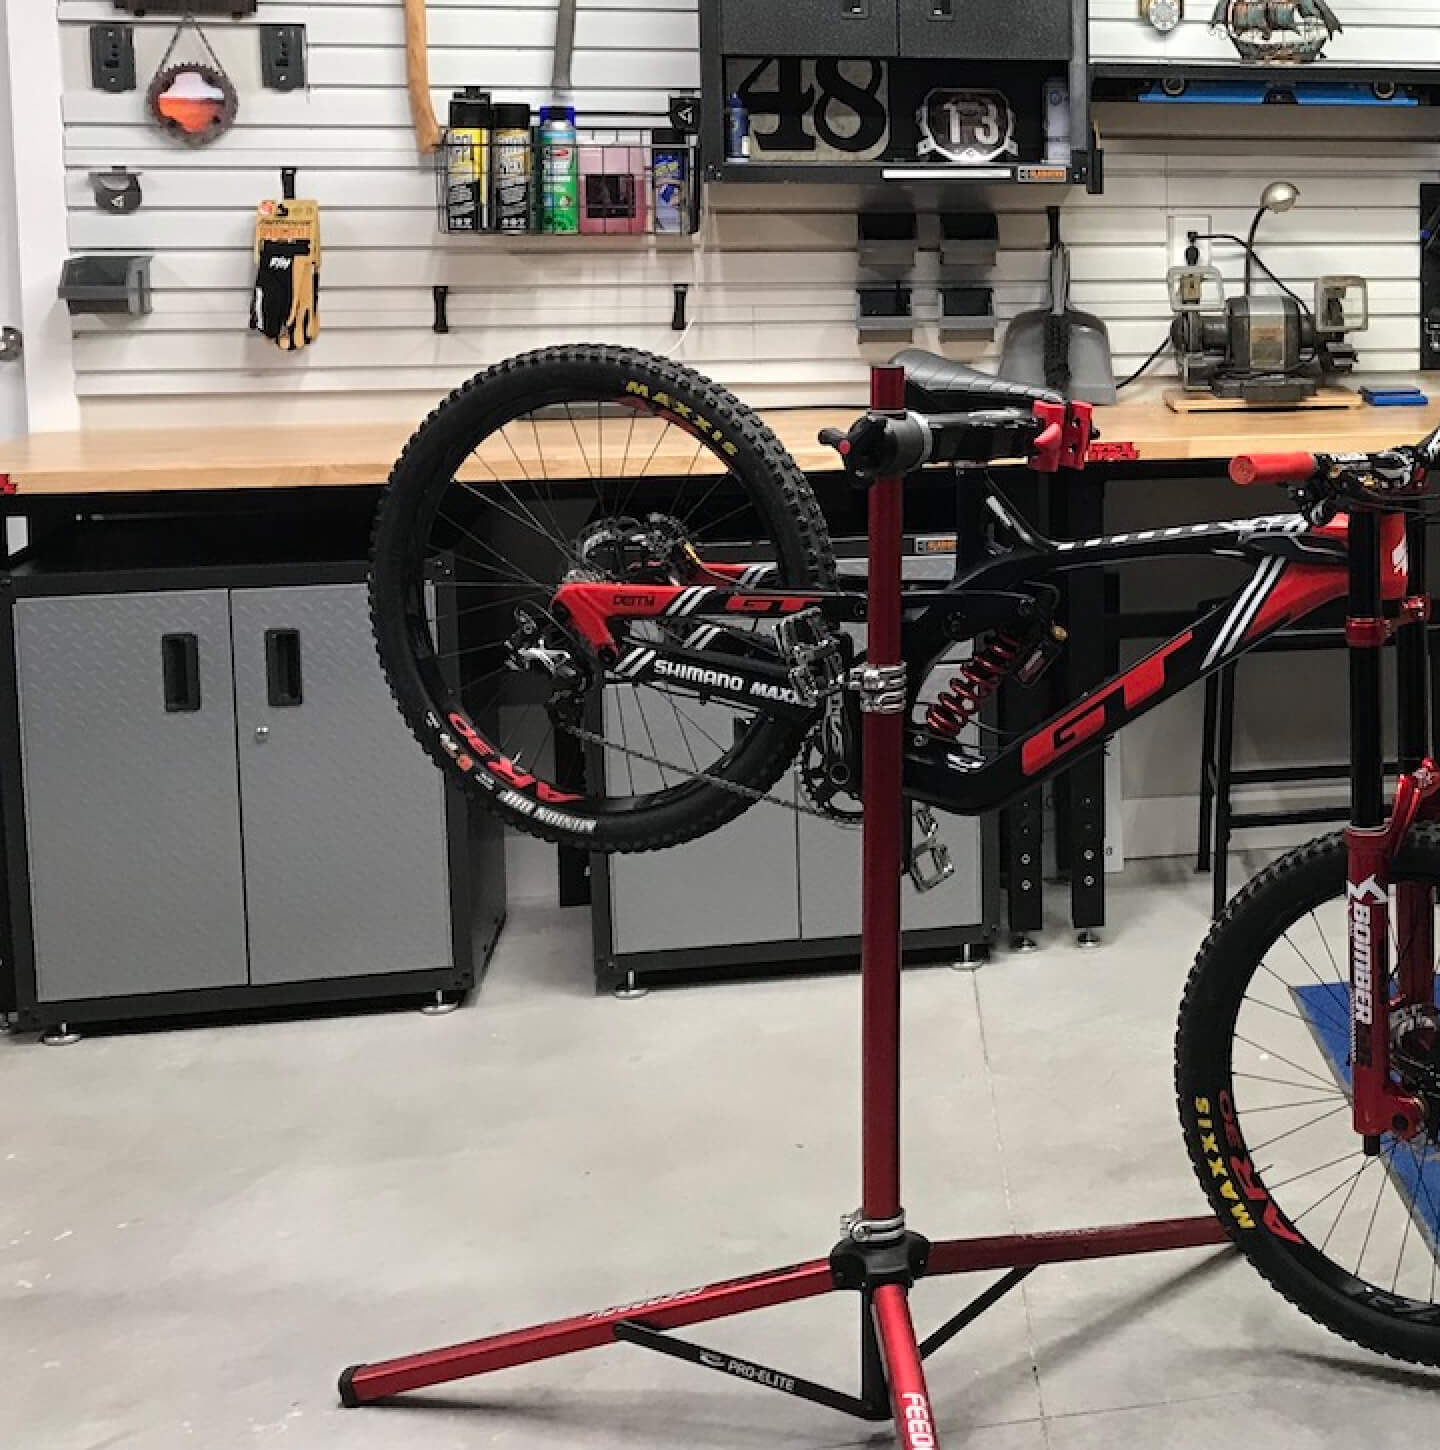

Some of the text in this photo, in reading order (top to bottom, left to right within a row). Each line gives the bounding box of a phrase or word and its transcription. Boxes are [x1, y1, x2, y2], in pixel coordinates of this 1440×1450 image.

[739, 56, 887, 153] 48
[944, 101, 1000, 146] 13
[625, 381, 739, 456] MAXXIS
[724, 594, 824, 612] GT
[653, 659, 745, 692] SHIMANO
[1022, 630, 1193, 777] GT
[1353, 903, 1374, 1025] BOMBER
[1194, 1096, 1257, 1229] MAXXIS
[727, 1358, 796, 1393] PRO-ELITE
[901, 1391, 935, 1450] FEED
